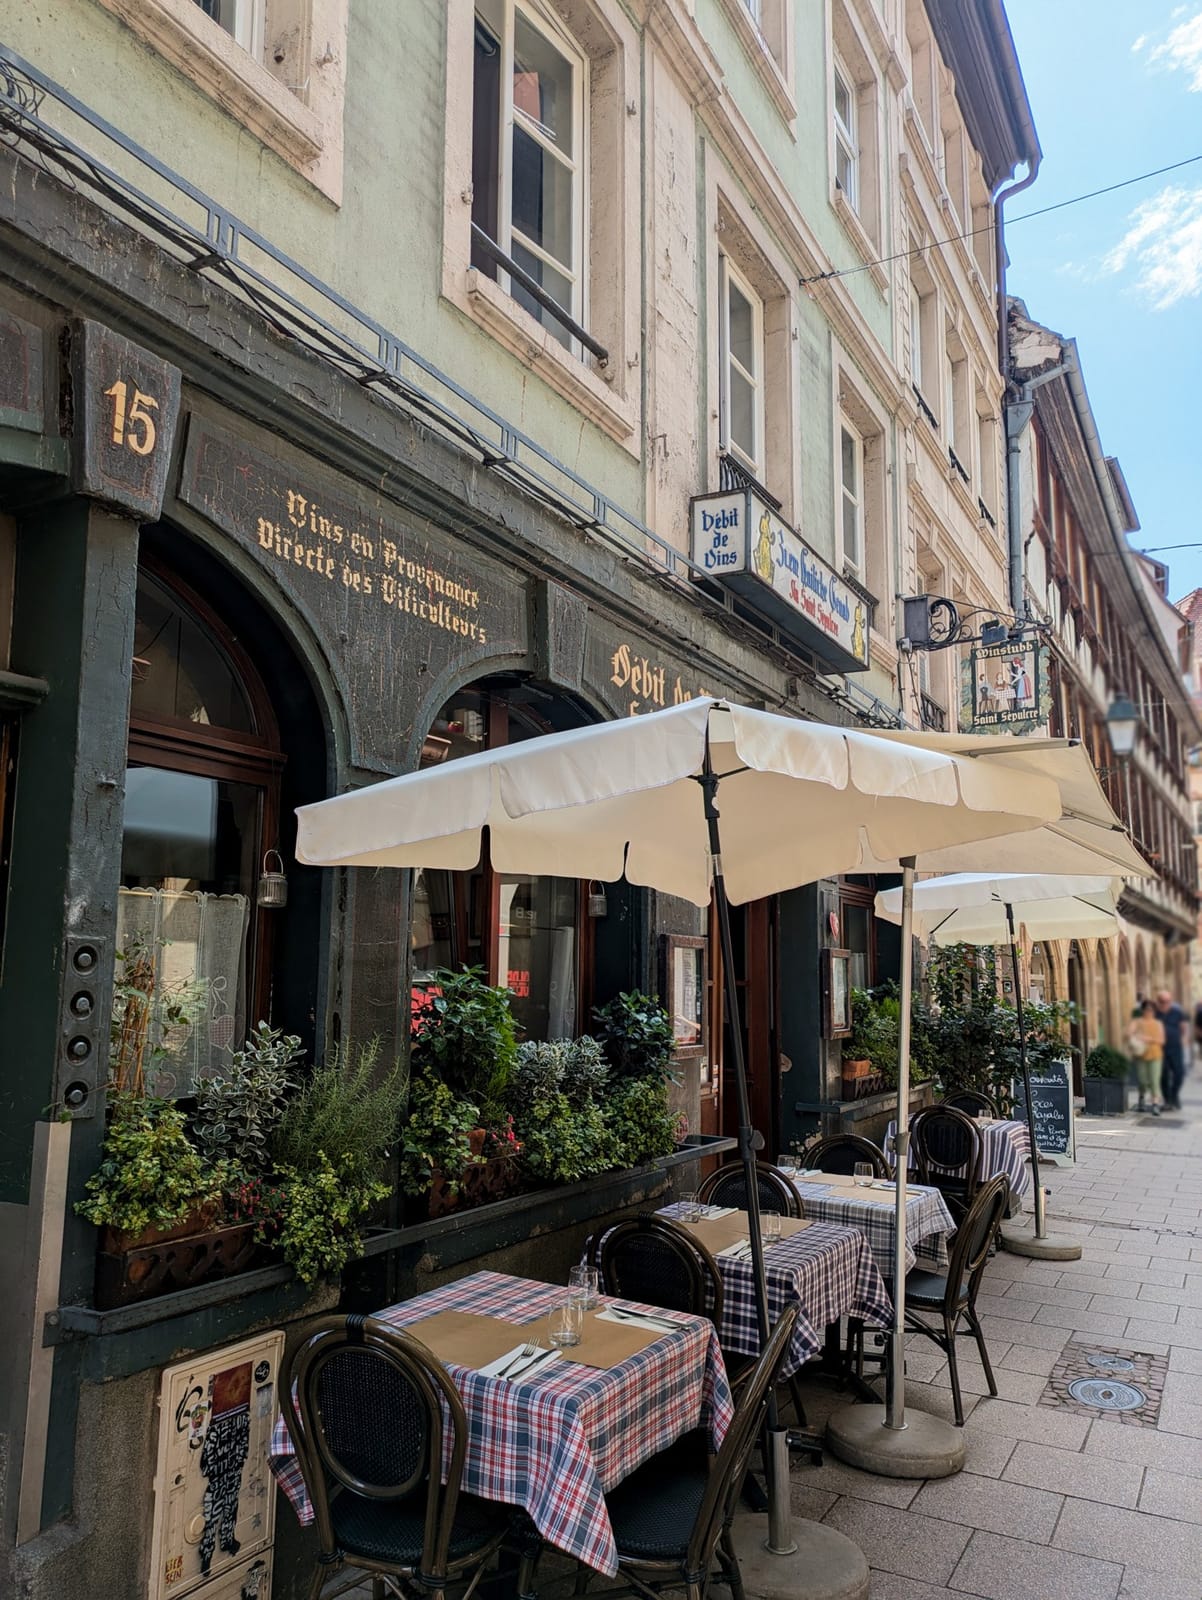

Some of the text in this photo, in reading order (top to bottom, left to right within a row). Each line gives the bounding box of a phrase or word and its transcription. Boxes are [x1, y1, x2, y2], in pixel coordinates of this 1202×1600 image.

[103, 380, 159, 455] 15
[702, 508, 739, 533] Débit
[287, 489, 480, 609] Vins en Provenance
[713, 530, 729, 549] de
[257, 516, 336, 580] Directe
[342, 559, 373, 594] des
[704, 550, 738, 569] Vins
[976, 641, 1033, 658] Winstubb
[610, 644, 666, 706] Débit
[973, 713, 998, 726] Saint
